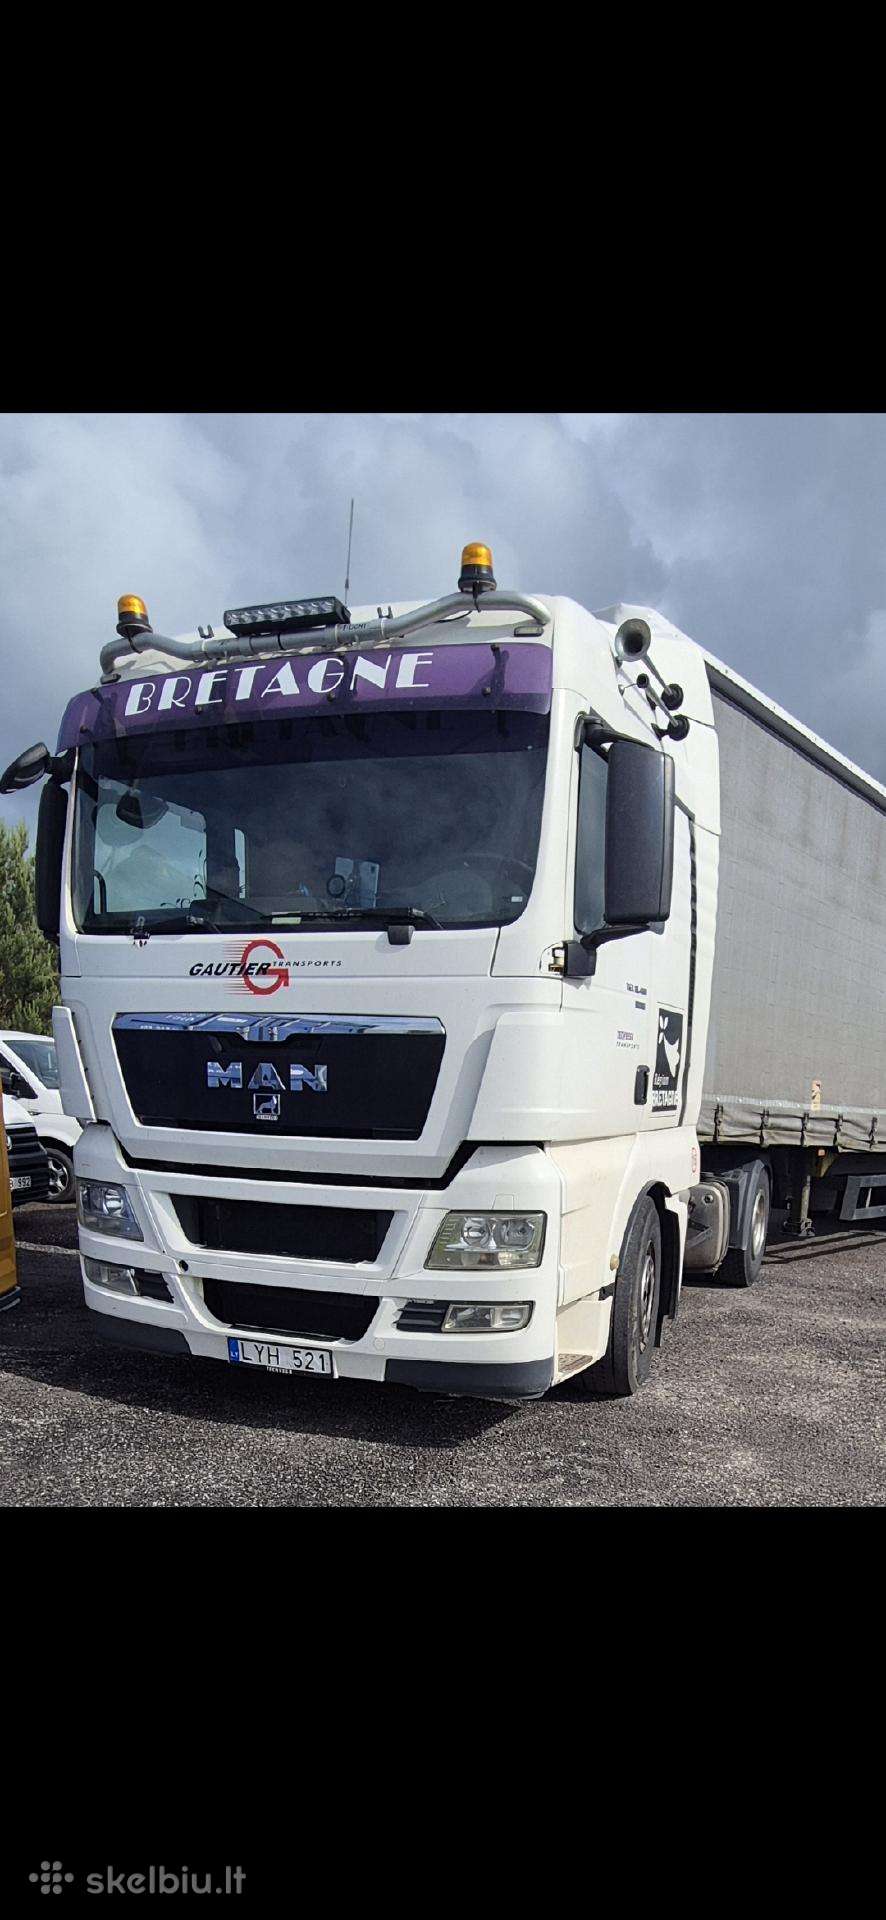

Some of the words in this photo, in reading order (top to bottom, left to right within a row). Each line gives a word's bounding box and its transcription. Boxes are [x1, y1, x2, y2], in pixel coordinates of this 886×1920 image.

[125, 653, 434, 717] BRETAGNE
[189, 963, 272, 977] GAUTIER
[273, 960, 343, 968] TRANSPORTS
[207, 1061, 328, 1092] MAN
[240, 1342, 280, 1366] LYH
[293, 1350, 326, 1372] 521
